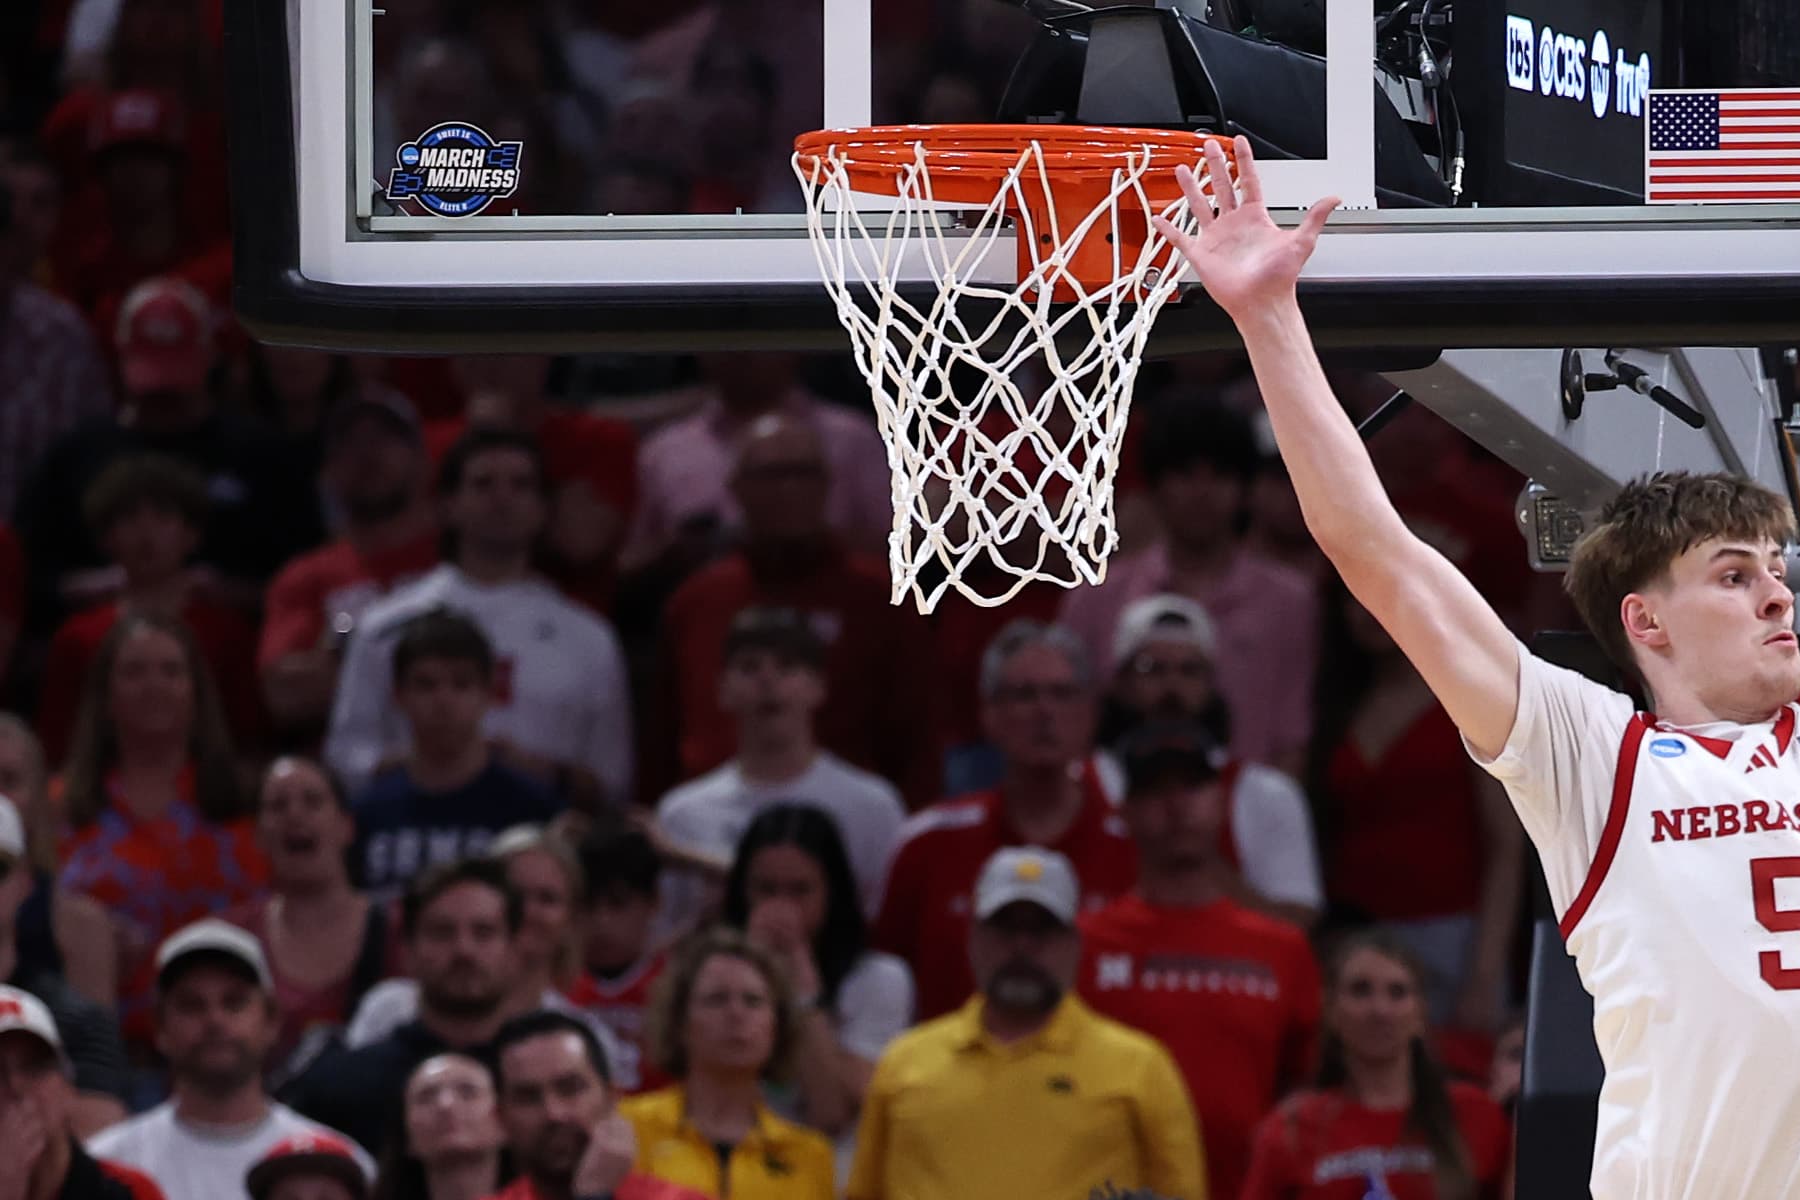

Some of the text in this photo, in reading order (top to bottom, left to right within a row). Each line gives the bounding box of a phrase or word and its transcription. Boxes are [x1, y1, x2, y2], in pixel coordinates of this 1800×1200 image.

[1554, 33, 1586, 101] CBS
[419, 148, 486, 168] MARCH
[426, 168, 516, 188] MADNESS
